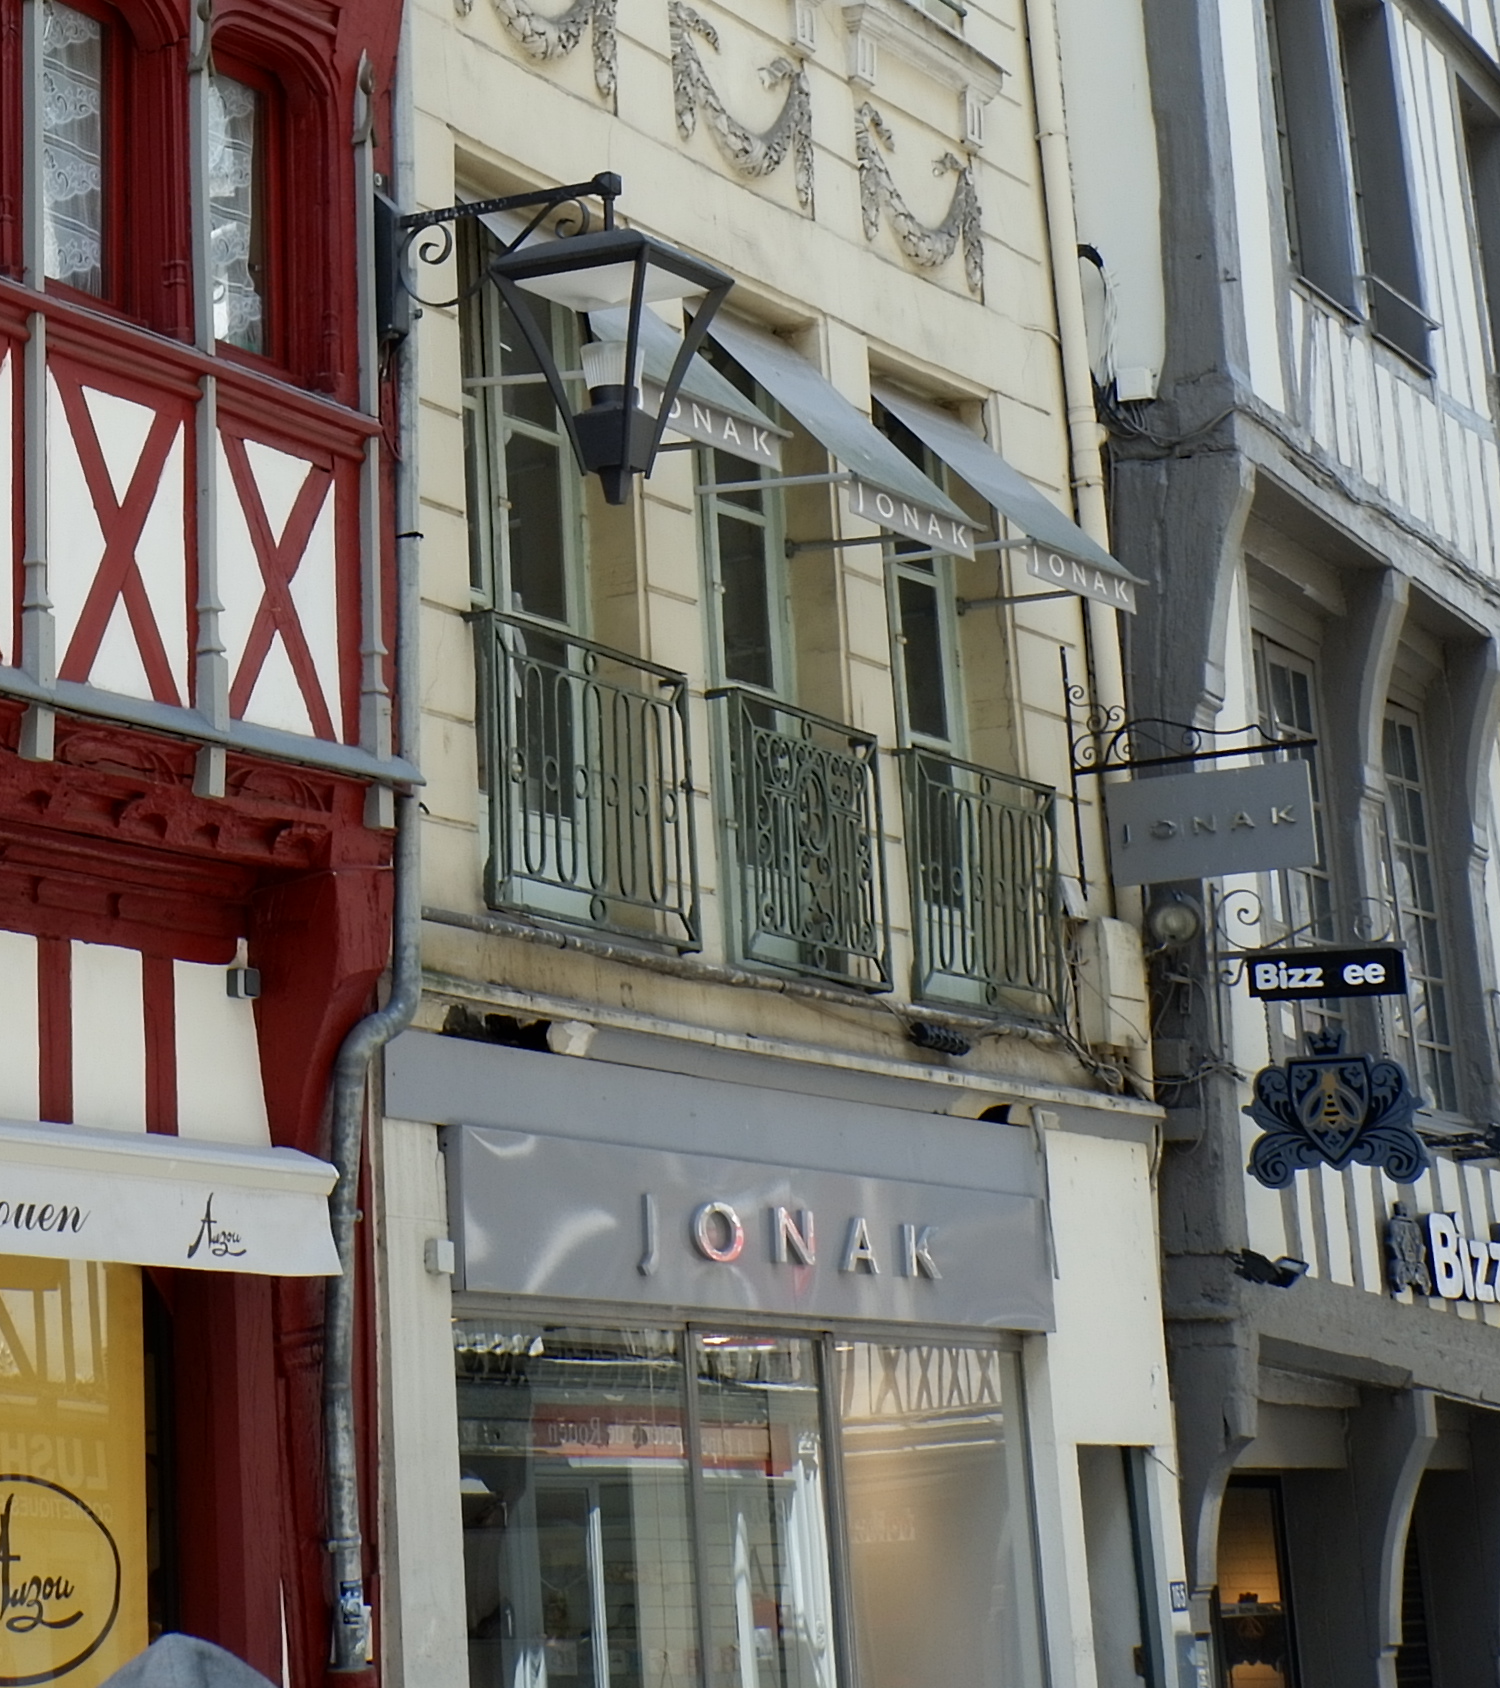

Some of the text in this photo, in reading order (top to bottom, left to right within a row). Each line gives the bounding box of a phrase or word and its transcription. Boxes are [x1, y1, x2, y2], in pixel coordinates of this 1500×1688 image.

[856, 482, 968, 549] JONAK
[1032, 545, 1129, 602] JONAK
[1122, 805, 1296, 850] JONAK
[187, 1191, 248, 1259] Auzou
[637, 1193, 943, 1281] JONAK
